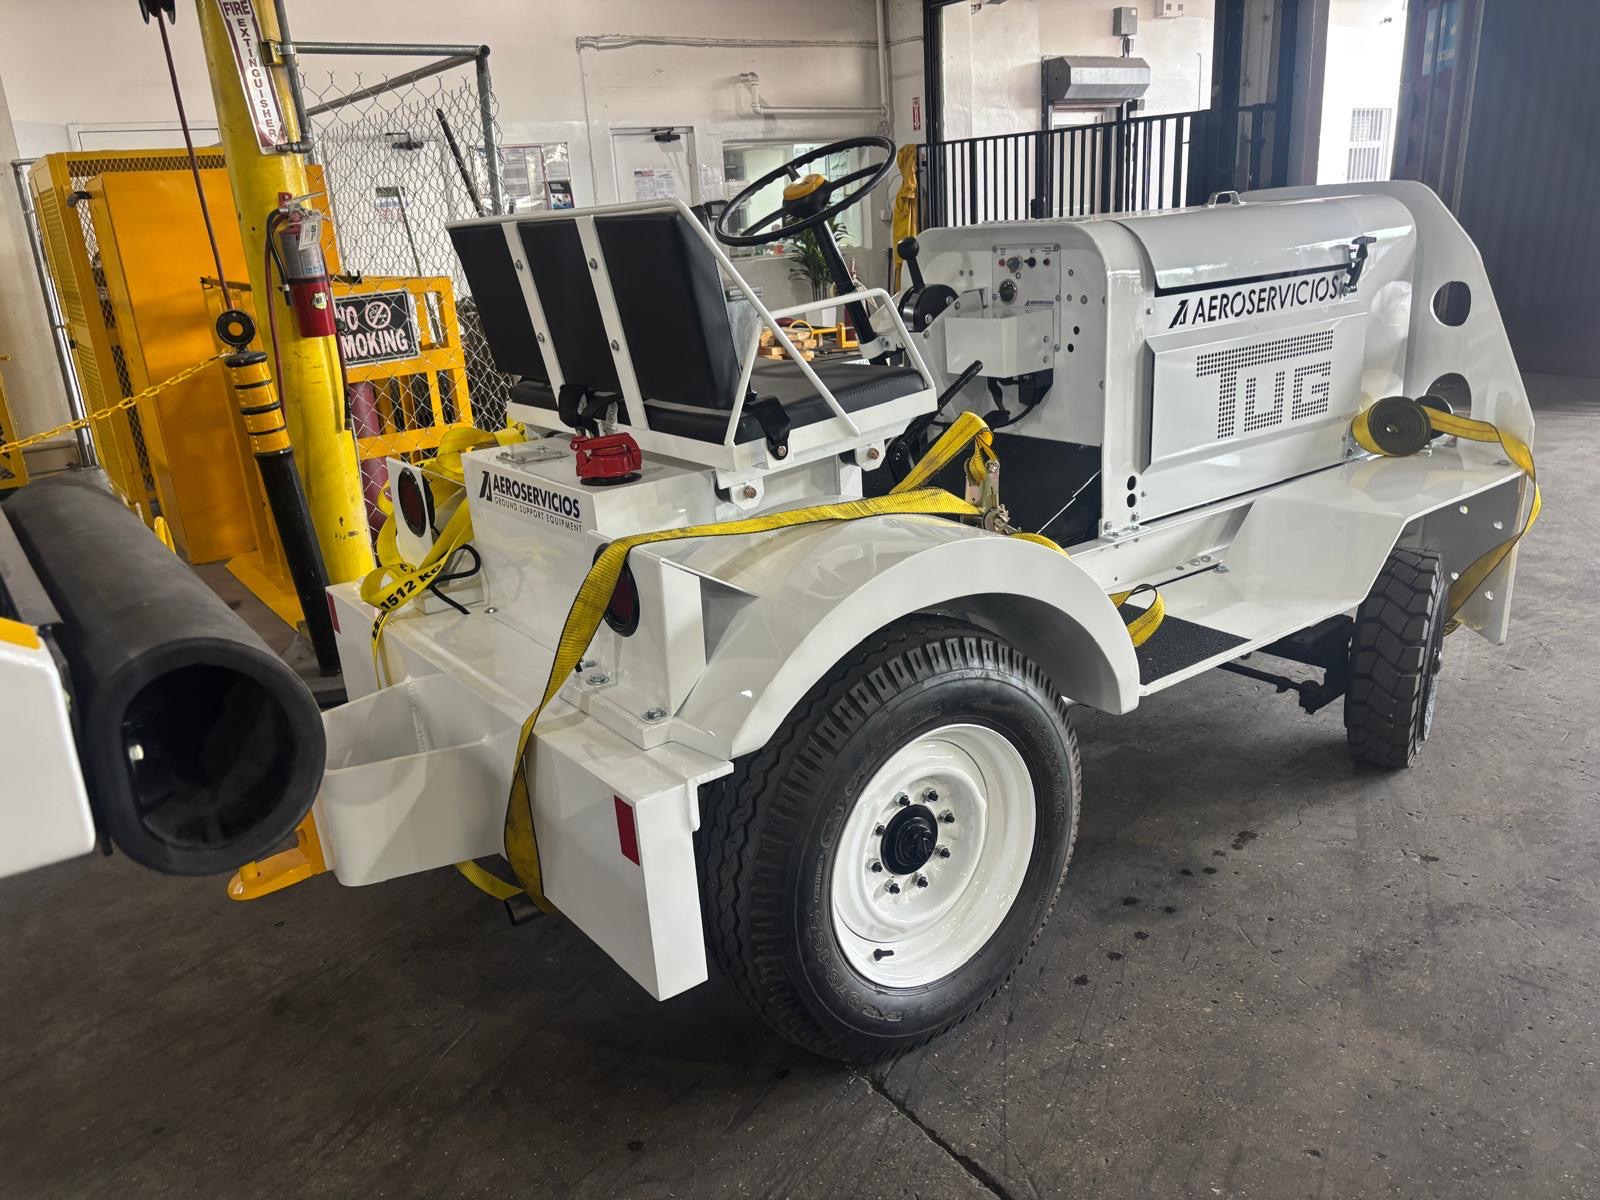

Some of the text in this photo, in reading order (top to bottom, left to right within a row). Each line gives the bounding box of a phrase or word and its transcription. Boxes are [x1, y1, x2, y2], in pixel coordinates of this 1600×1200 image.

[221, 0, 251, 17] FIRE
[237, 18, 277, 138] EXTINGUISHER
[1191, 275, 1339, 325] AEROSERVICIOS
[340, 328, 409, 360] MOKING
[1196, 328, 1334, 440] TUG
[493, 473, 581, 519] AEROSERVICIOS
[494, 496, 583, 534] GROUND SUPPORT EQUIPMENT
[380, 580, 417, 610] 1512
